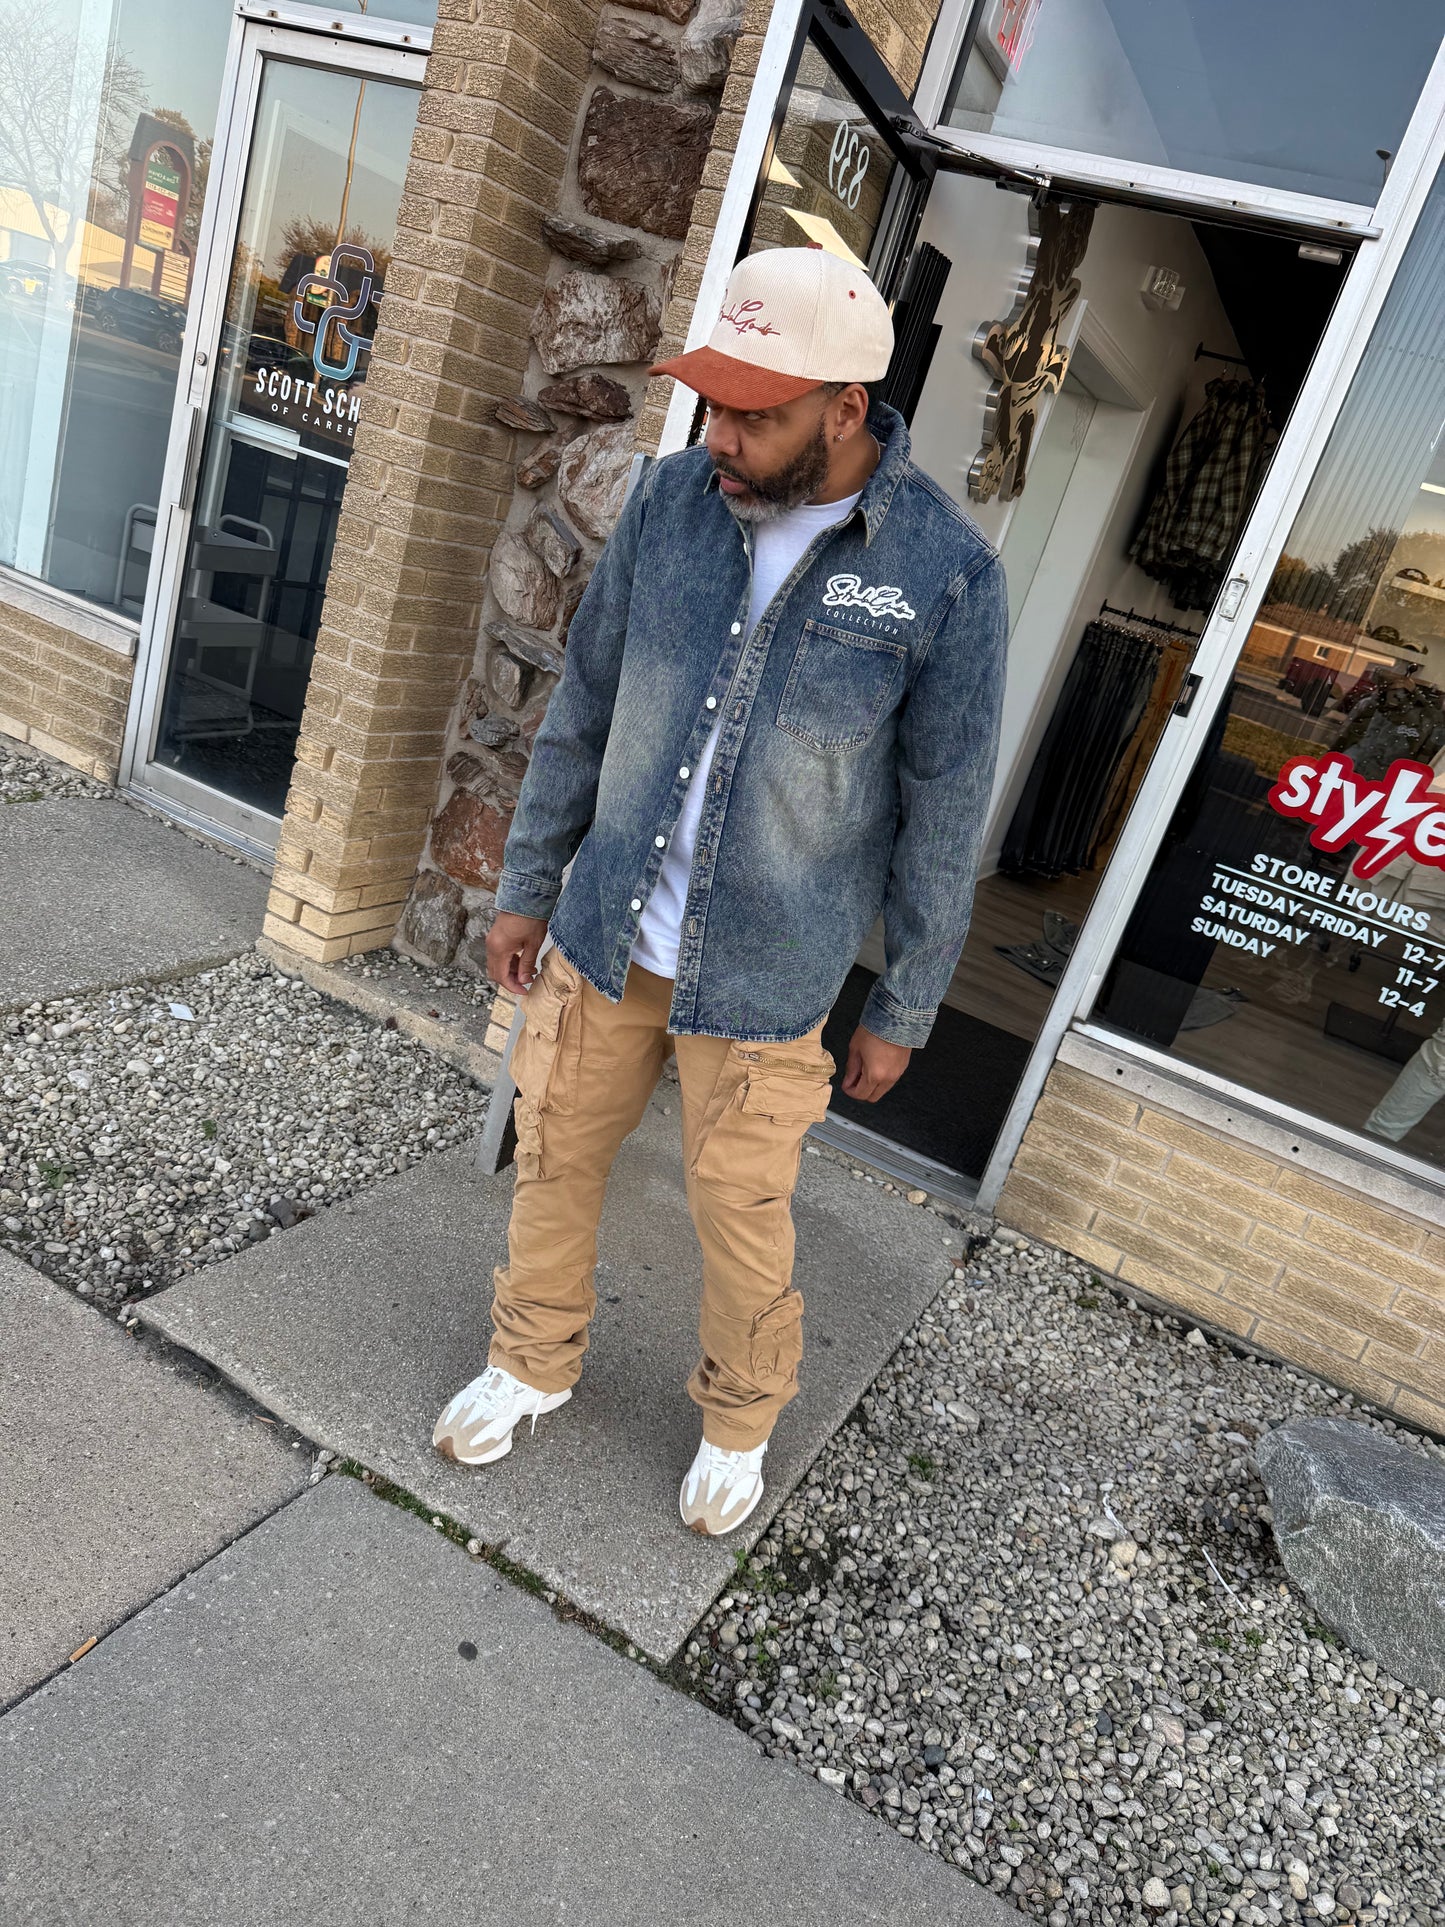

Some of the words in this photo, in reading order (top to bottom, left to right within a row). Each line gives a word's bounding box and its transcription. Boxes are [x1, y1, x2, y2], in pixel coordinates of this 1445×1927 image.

[255, 367, 316, 408] SCOTT
[322, 388, 362, 423] SCH
[271, 403, 289, 415] OF
[302, 412, 354, 437] CAREE
[826, 608, 898, 635] COLLECTION
[1210, 872, 1388, 949] TUESDAY-FRIDAY
[1401, 943, 1445, 972] 12-7
[1250, 853, 1336, 898] STORE
[1335, 887, 1432, 932] HOURS
[1190, 917, 1277, 958] SUNDAY
[1377, 986, 1427, 1018] 12-4
[1200, 895, 1311, 946] SATURDAY
[1395, 967, 1439, 994] 11-7
